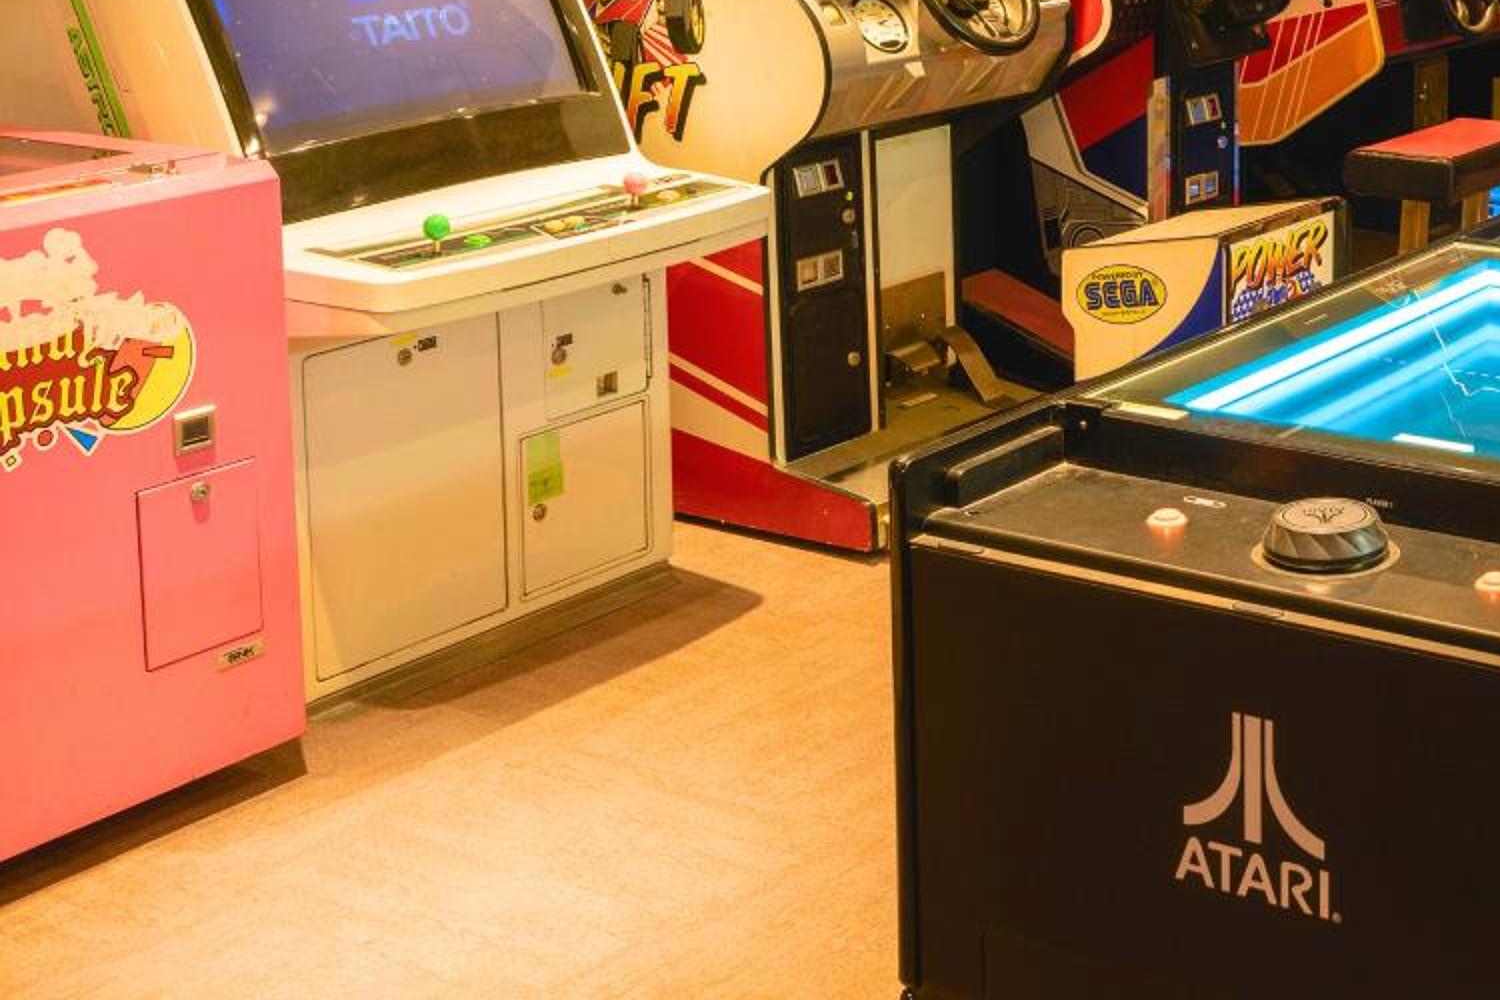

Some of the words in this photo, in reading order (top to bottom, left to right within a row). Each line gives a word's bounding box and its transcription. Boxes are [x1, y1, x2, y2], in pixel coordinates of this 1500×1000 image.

[351, 4, 471, 48] TAITO
[1231, 220, 1329, 289] POWER
[1084, 278, 1160, 311] SEGA
[1174, 836, 1331, 921] ATARI
